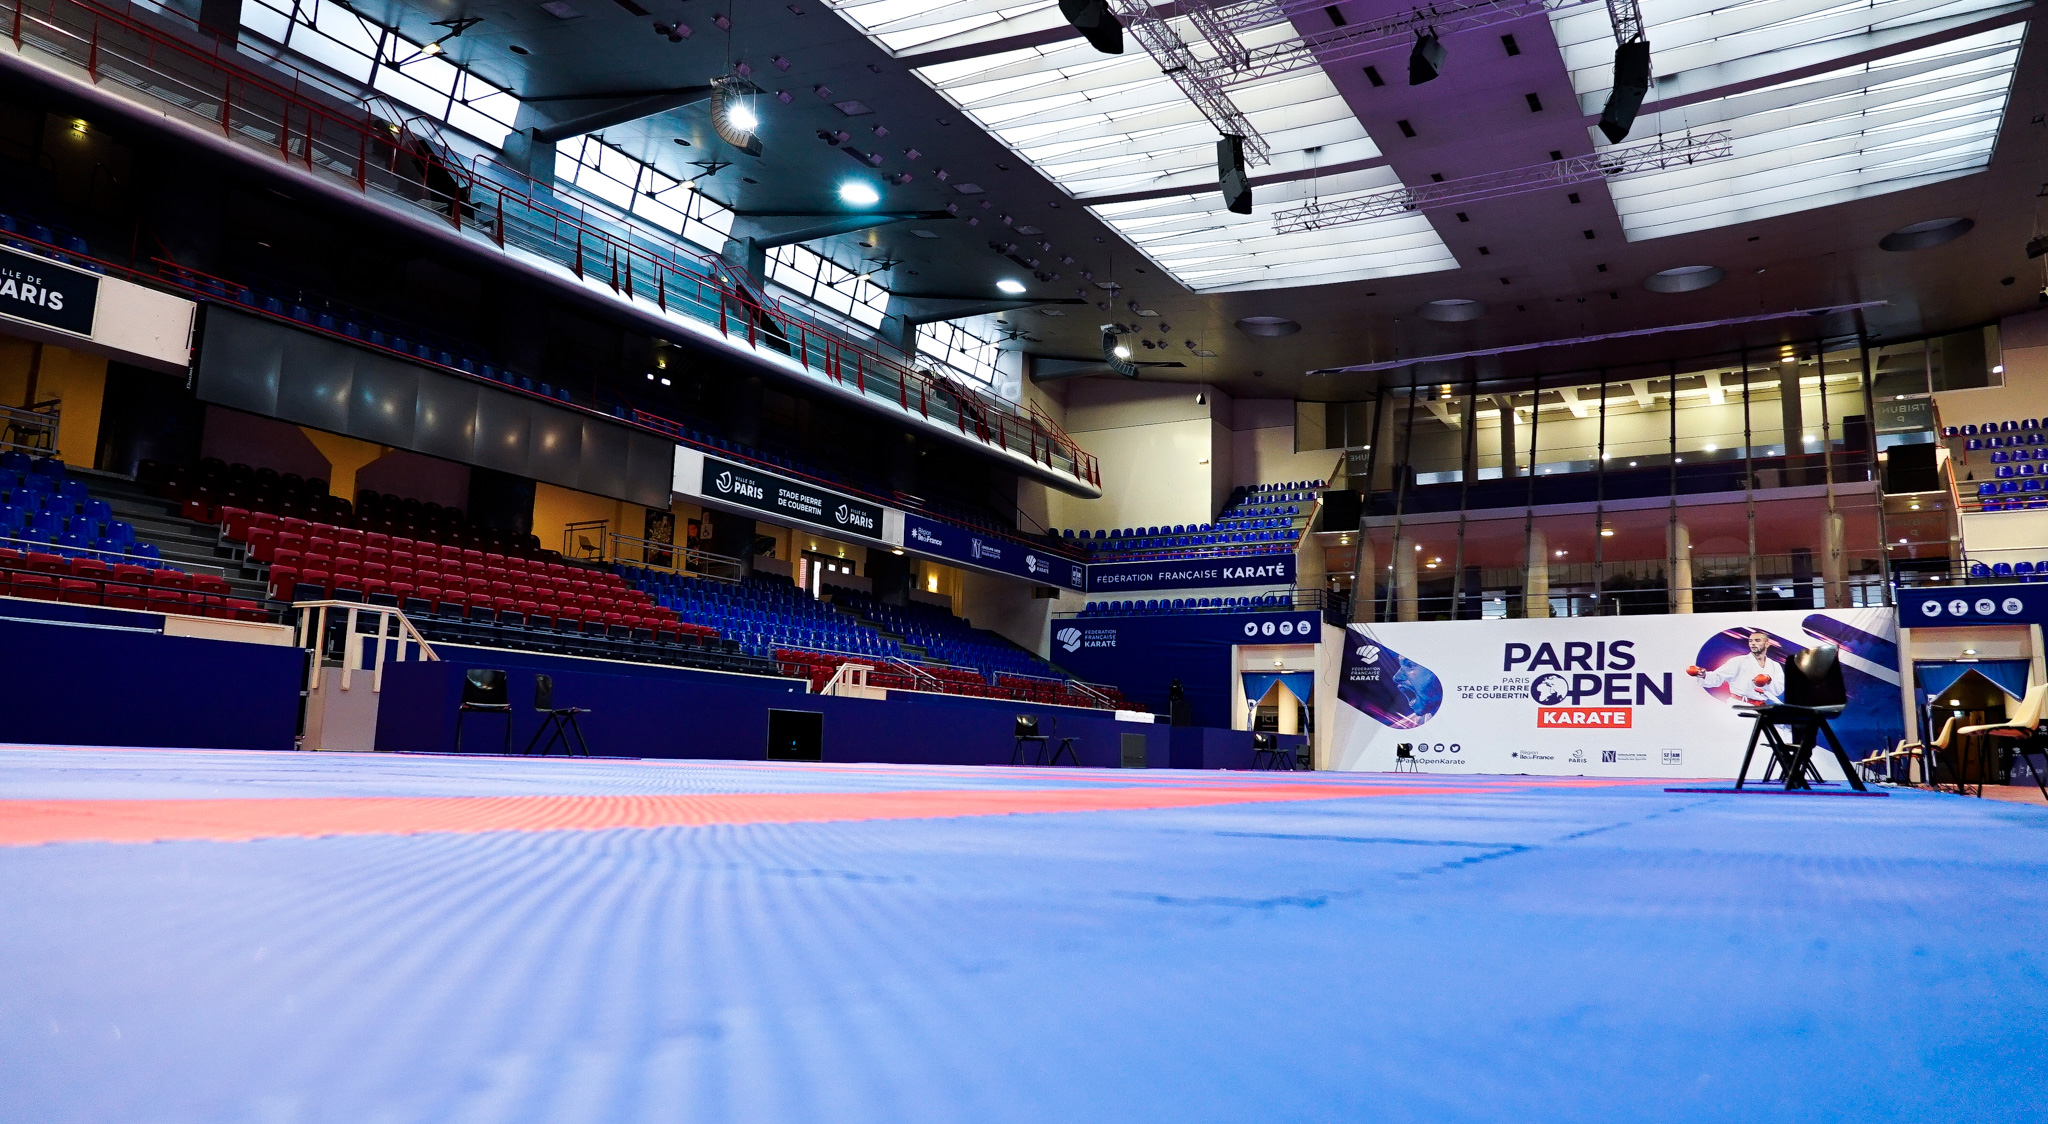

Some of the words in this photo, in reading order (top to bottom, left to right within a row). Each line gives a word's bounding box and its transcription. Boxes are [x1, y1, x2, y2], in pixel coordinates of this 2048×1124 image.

[2, 268, 21, 279] LLE
[27, 275, 42, 285] DE
[0, 278, 64, 310] ARIS
[734, 481, 763, 500] PARIS
[778, 488, 799, 500] STADE
[800, 494, 822, 507] PIERRE
[777, 497, 787, 507] DE
[787, 500, 822, 515] COUBERTIN
[850, 513, 874, 529] PARIS
[1096, 572, 1153, 583] FÉDÉRATION
[1158, 569, 1218, 581] FRANÇAISE
[1223, 562, 1285, 579] KARATÉ
[1084, 639, 1117, 647] KARATÉ
[1503, 640, 1636, 672] PARIS
[1531, 672, 1673, 706] OPEN
[1543, 711, 1626, 724] KARATE
